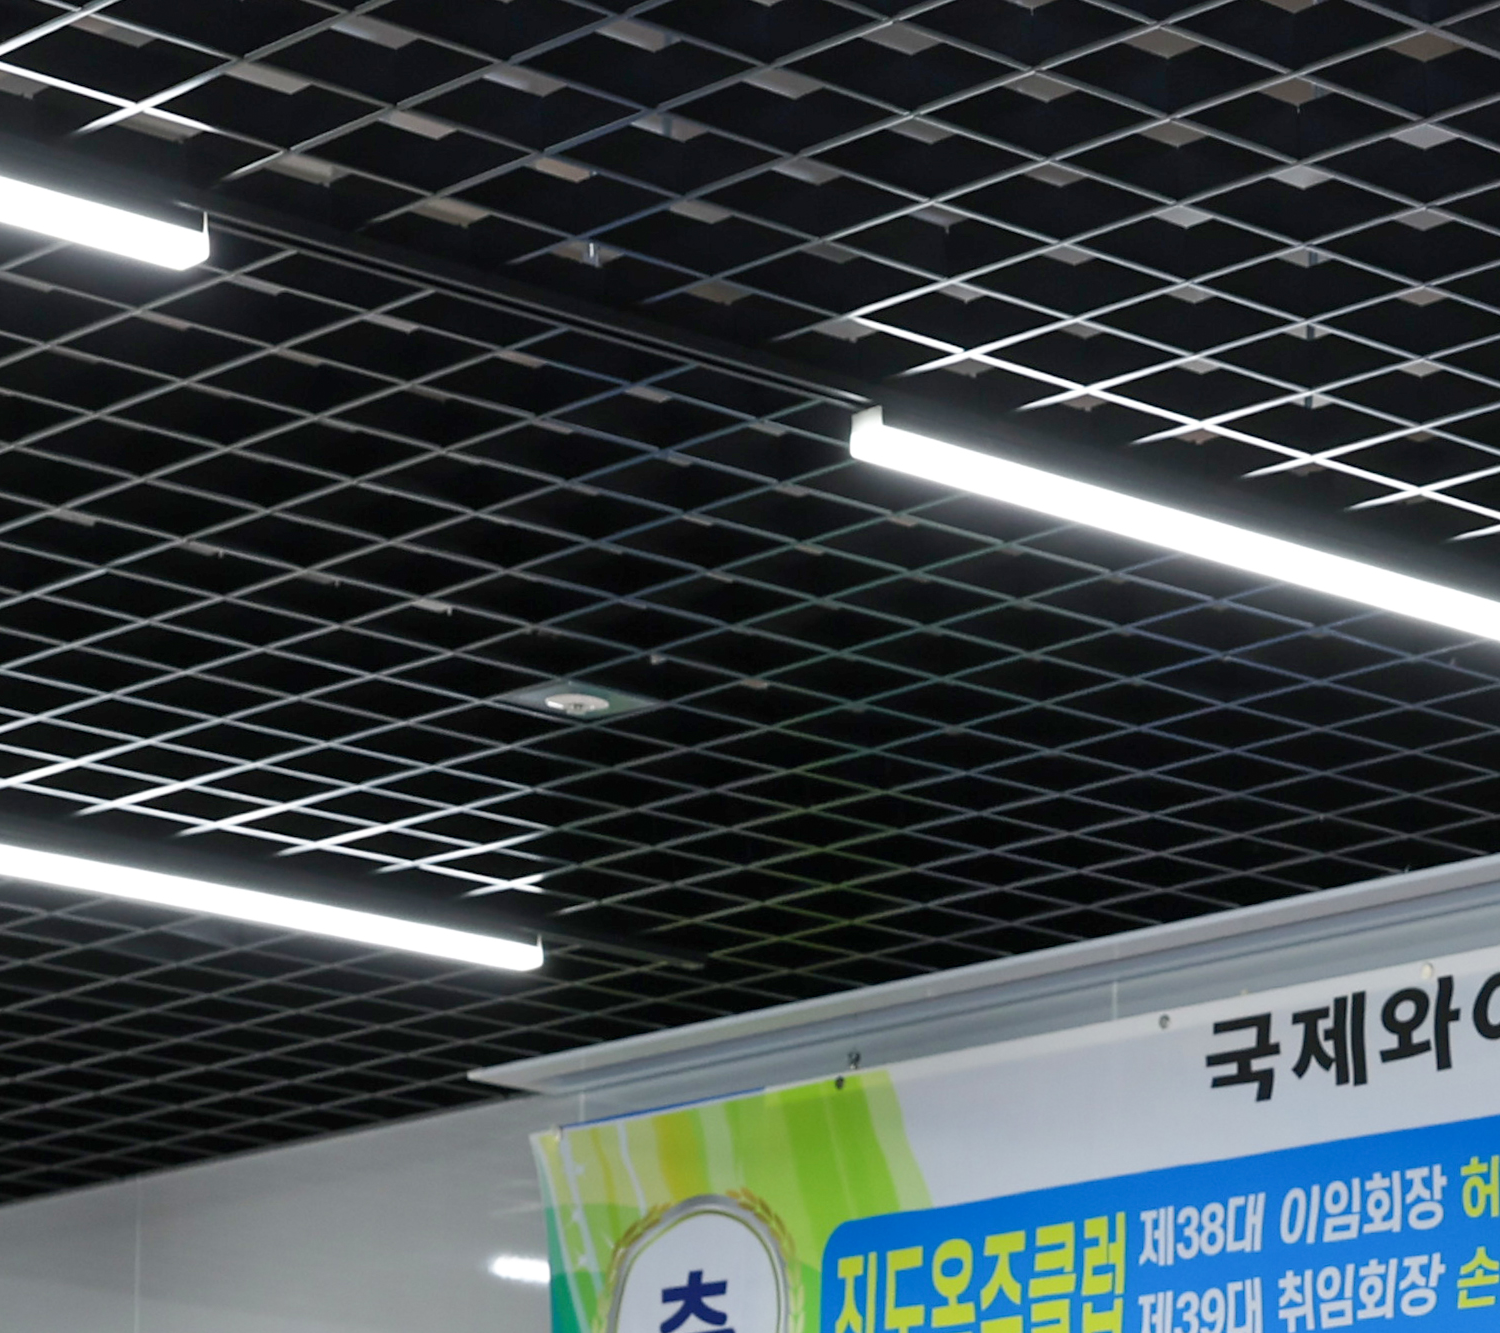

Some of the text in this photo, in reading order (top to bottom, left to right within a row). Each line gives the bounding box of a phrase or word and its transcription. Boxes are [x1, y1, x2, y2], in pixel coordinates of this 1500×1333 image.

[1140, 1202, 1264, 1265] 제38대
[1281, 1165, 1446, 1243] 이임회장
[1279, 1254, 1445, 1333] 취임회장
